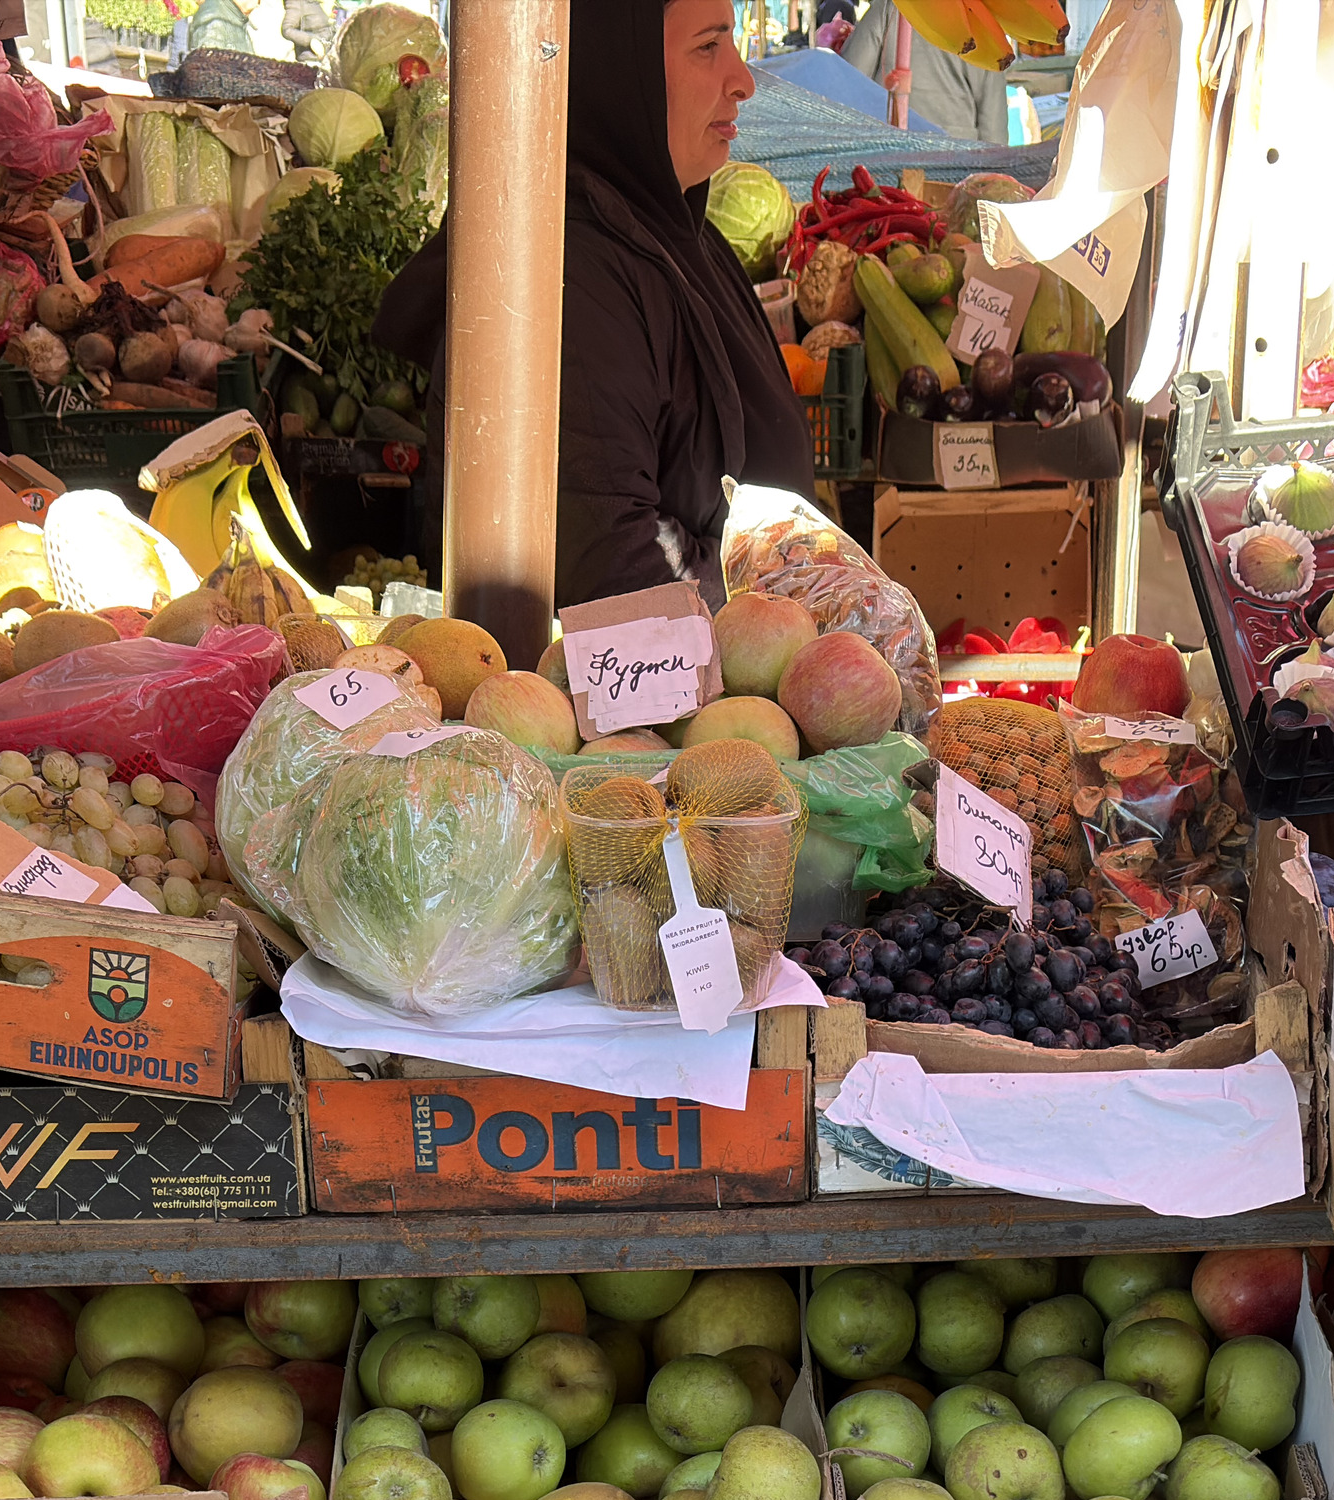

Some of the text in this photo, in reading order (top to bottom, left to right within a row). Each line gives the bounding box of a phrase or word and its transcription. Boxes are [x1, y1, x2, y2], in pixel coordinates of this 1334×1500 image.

[678, 926, 695, 936] STAR
[695, 920, 714, 931] FRUIT
[685, 962, 711, 977] KIWIS
[82, 1025, 149, 1050] ASOP
[29, 1040, 199, 1086] EIRINOUPOLIS
[409, 1094, 702, 1174] Frutas Ponti
[150, 1173, 271, 1185] www.westfruits.com.ua
[223, 1185, 243, 1196] 775
